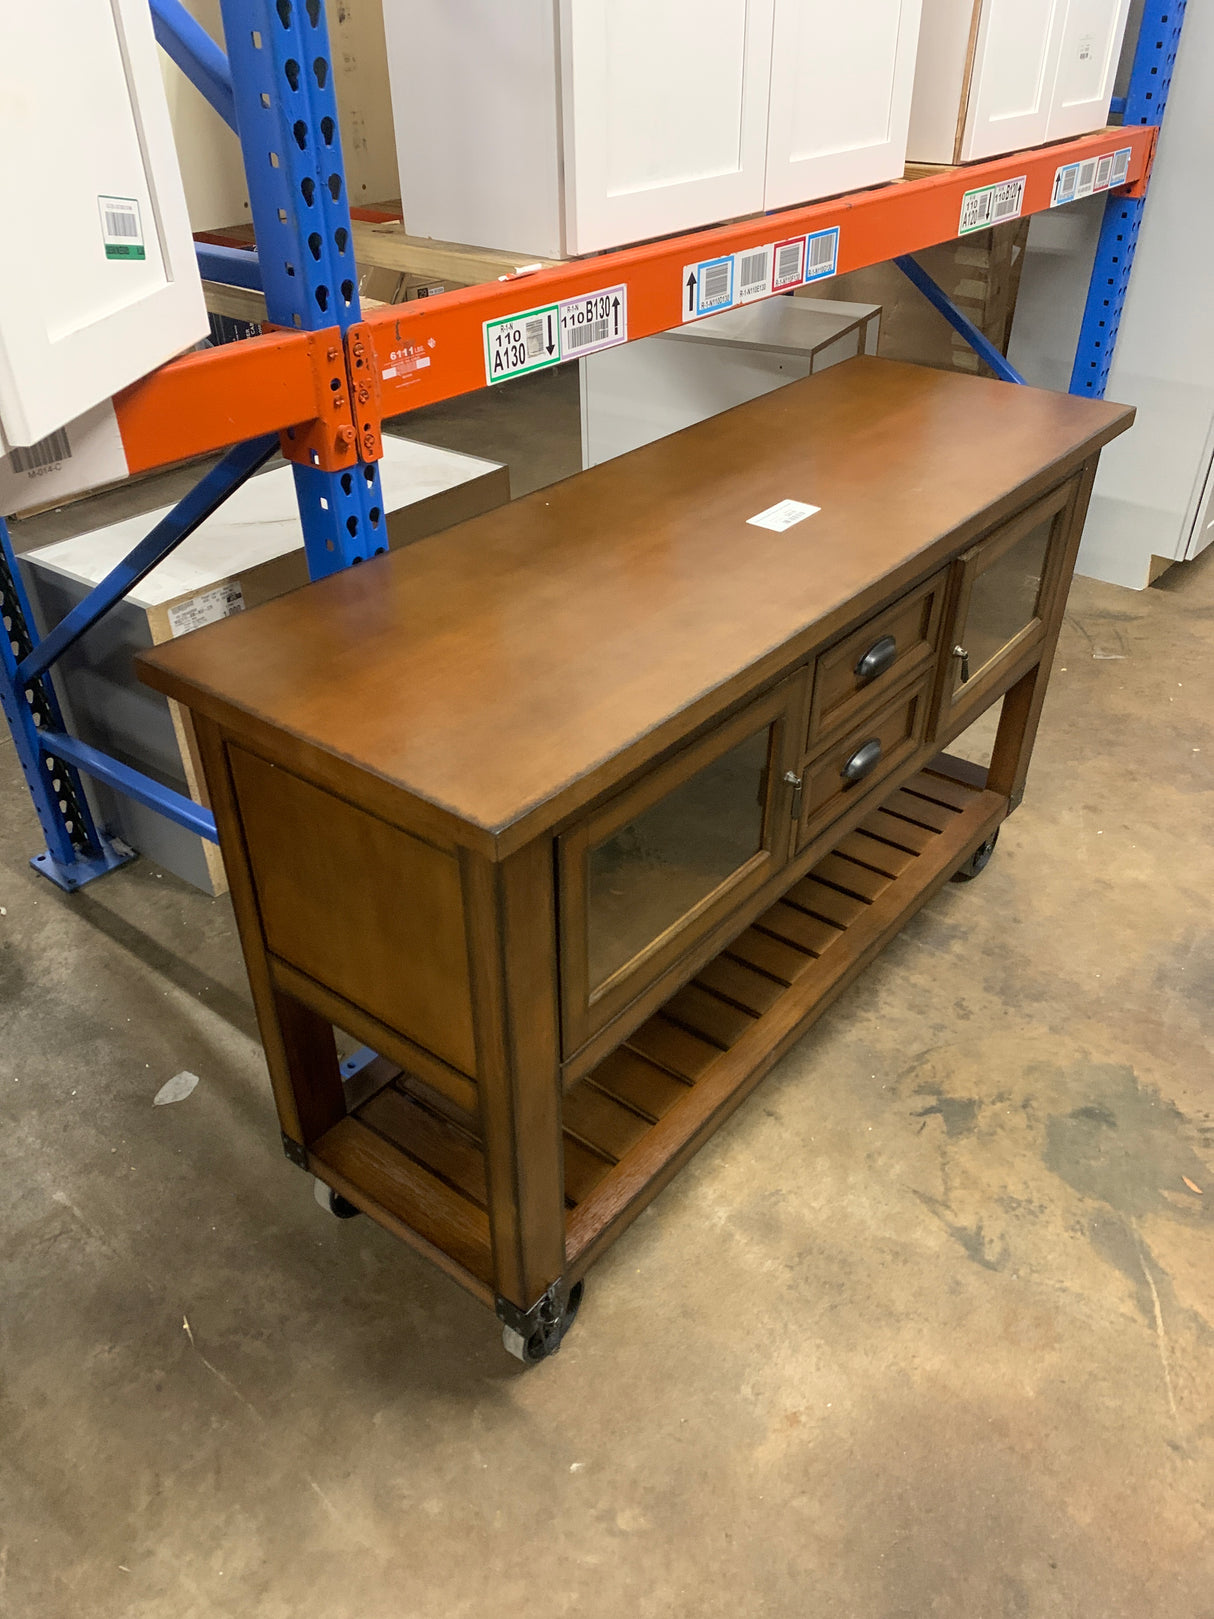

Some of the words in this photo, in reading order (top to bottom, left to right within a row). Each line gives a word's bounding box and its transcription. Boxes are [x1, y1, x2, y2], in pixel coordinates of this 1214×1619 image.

[967, 200, 978, 211] 110
[567, 305, 579, 313] R-1-N
[495, 329, 522, 348] 110
[390, 346, 414, 360] 6111
[493, 342, 526, 374] A130
